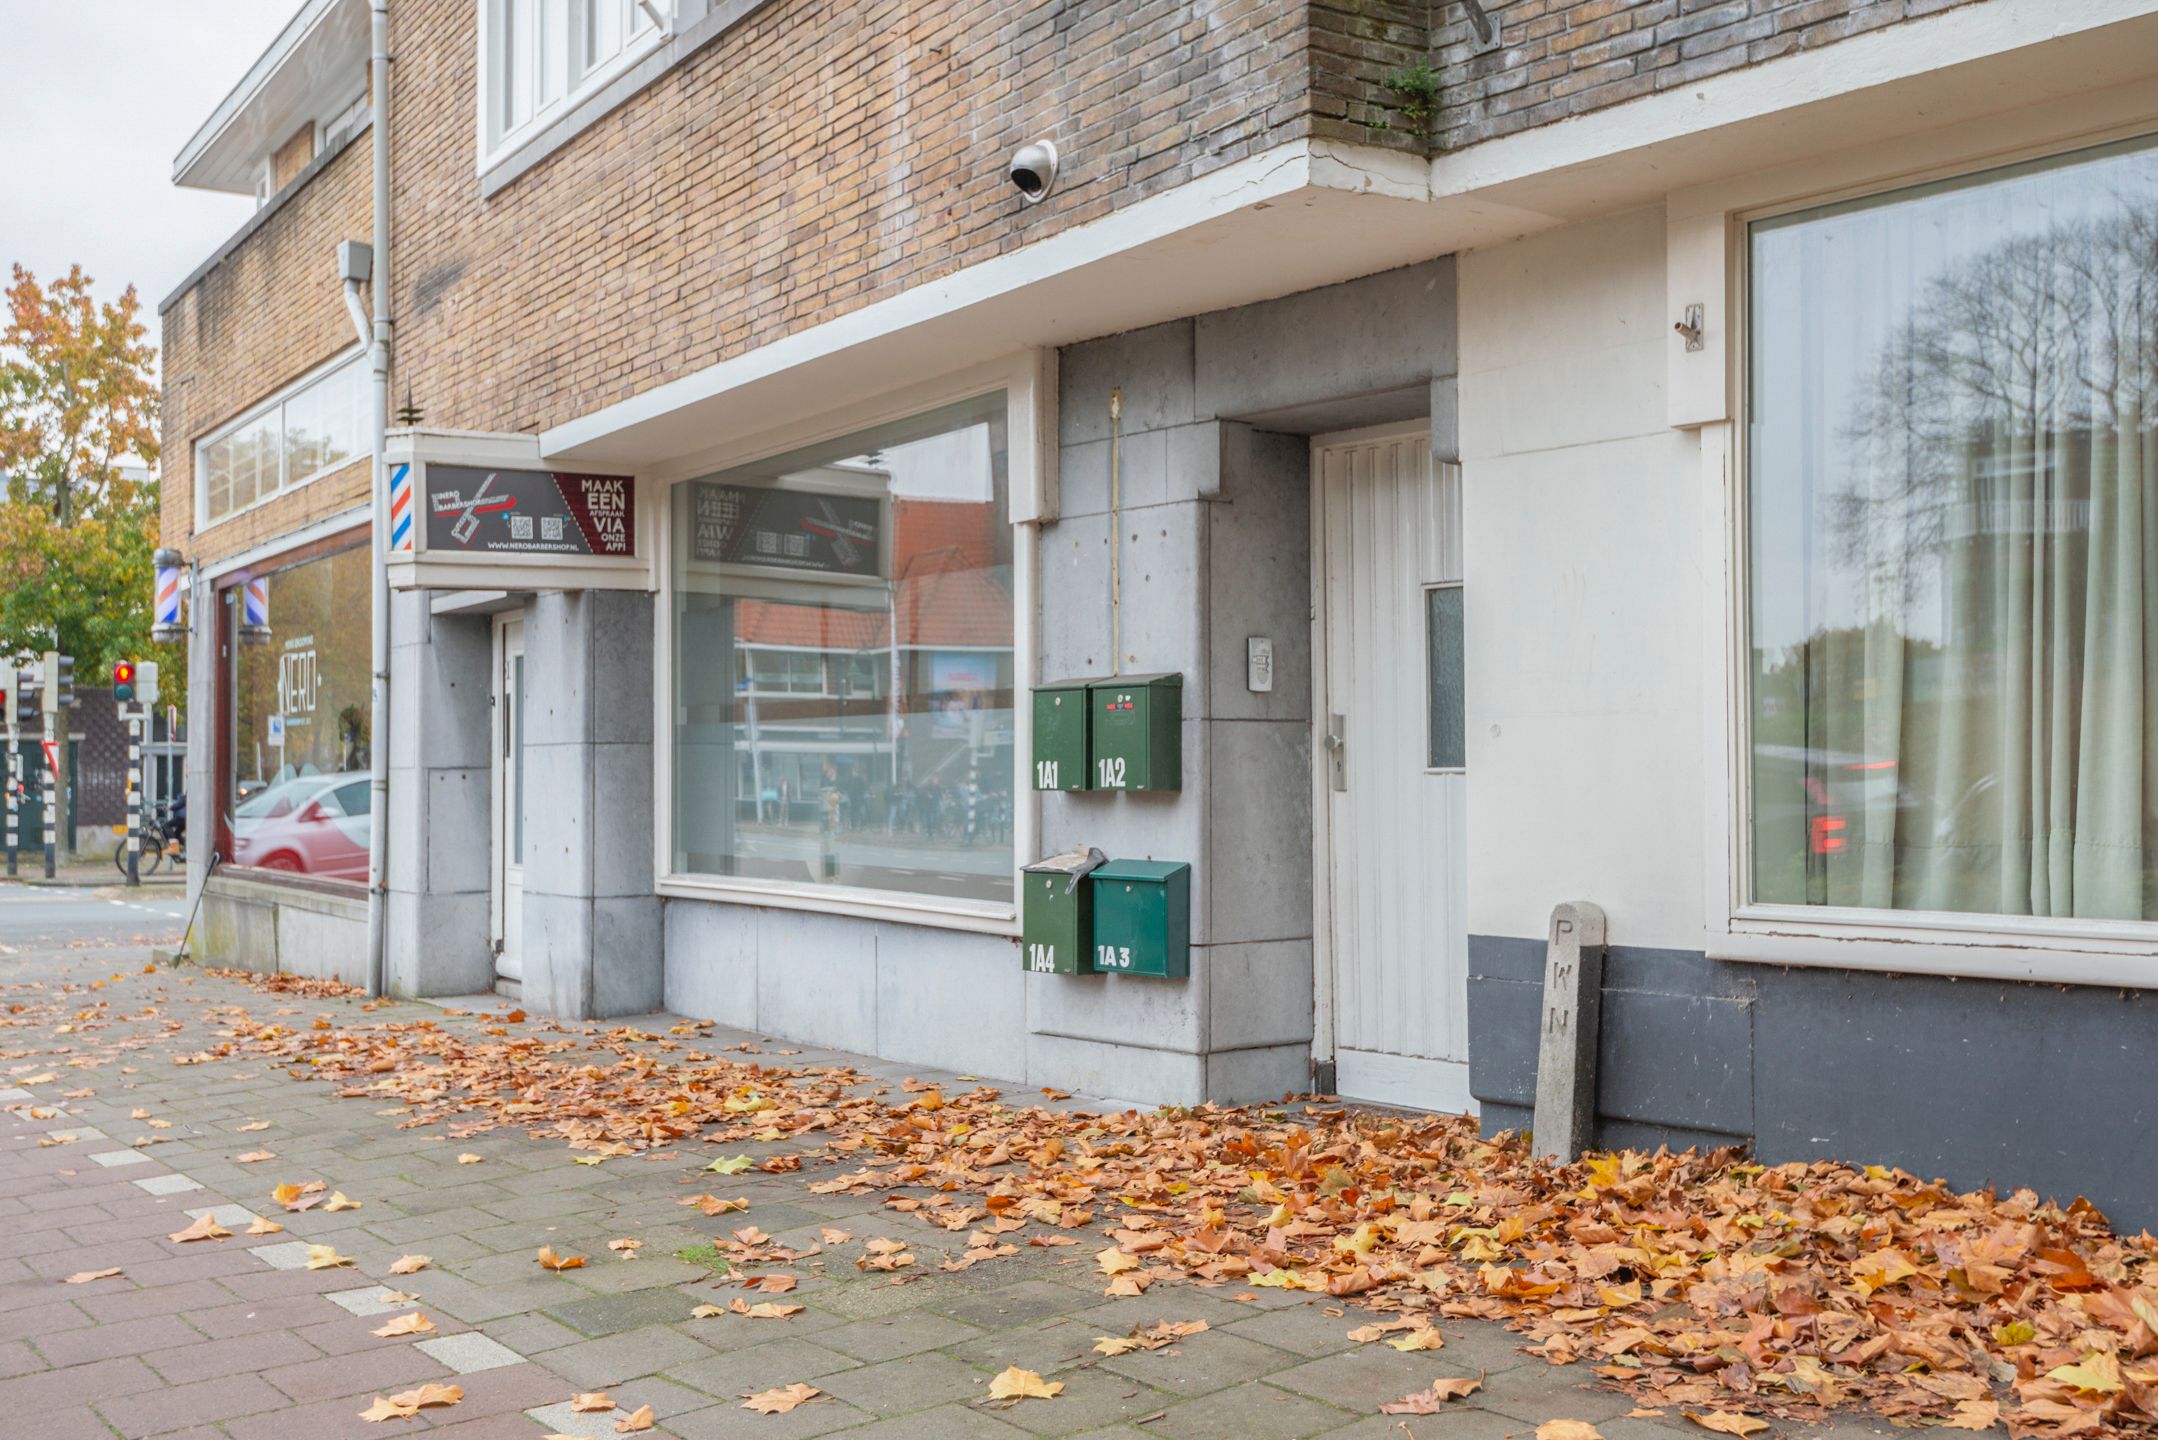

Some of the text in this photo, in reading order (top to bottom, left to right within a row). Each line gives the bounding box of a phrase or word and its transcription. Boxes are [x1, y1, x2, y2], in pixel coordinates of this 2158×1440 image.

[581, 480, 624, 492] MAAK
[588, 493, 625, 510] EEN
[593, 517, 625, 533] VIA
[601, 533, 625, 542] ONZE
[487, 542, 579, 552] WWW.NEROBARBERSHOP.NL
[279, 650, 317, 714] NERO
[1037, 760, 1058, 789] 1A1
[1099, 757, 1126, 788] 1A2
[1029, 943, 1055, 973] 1A4
